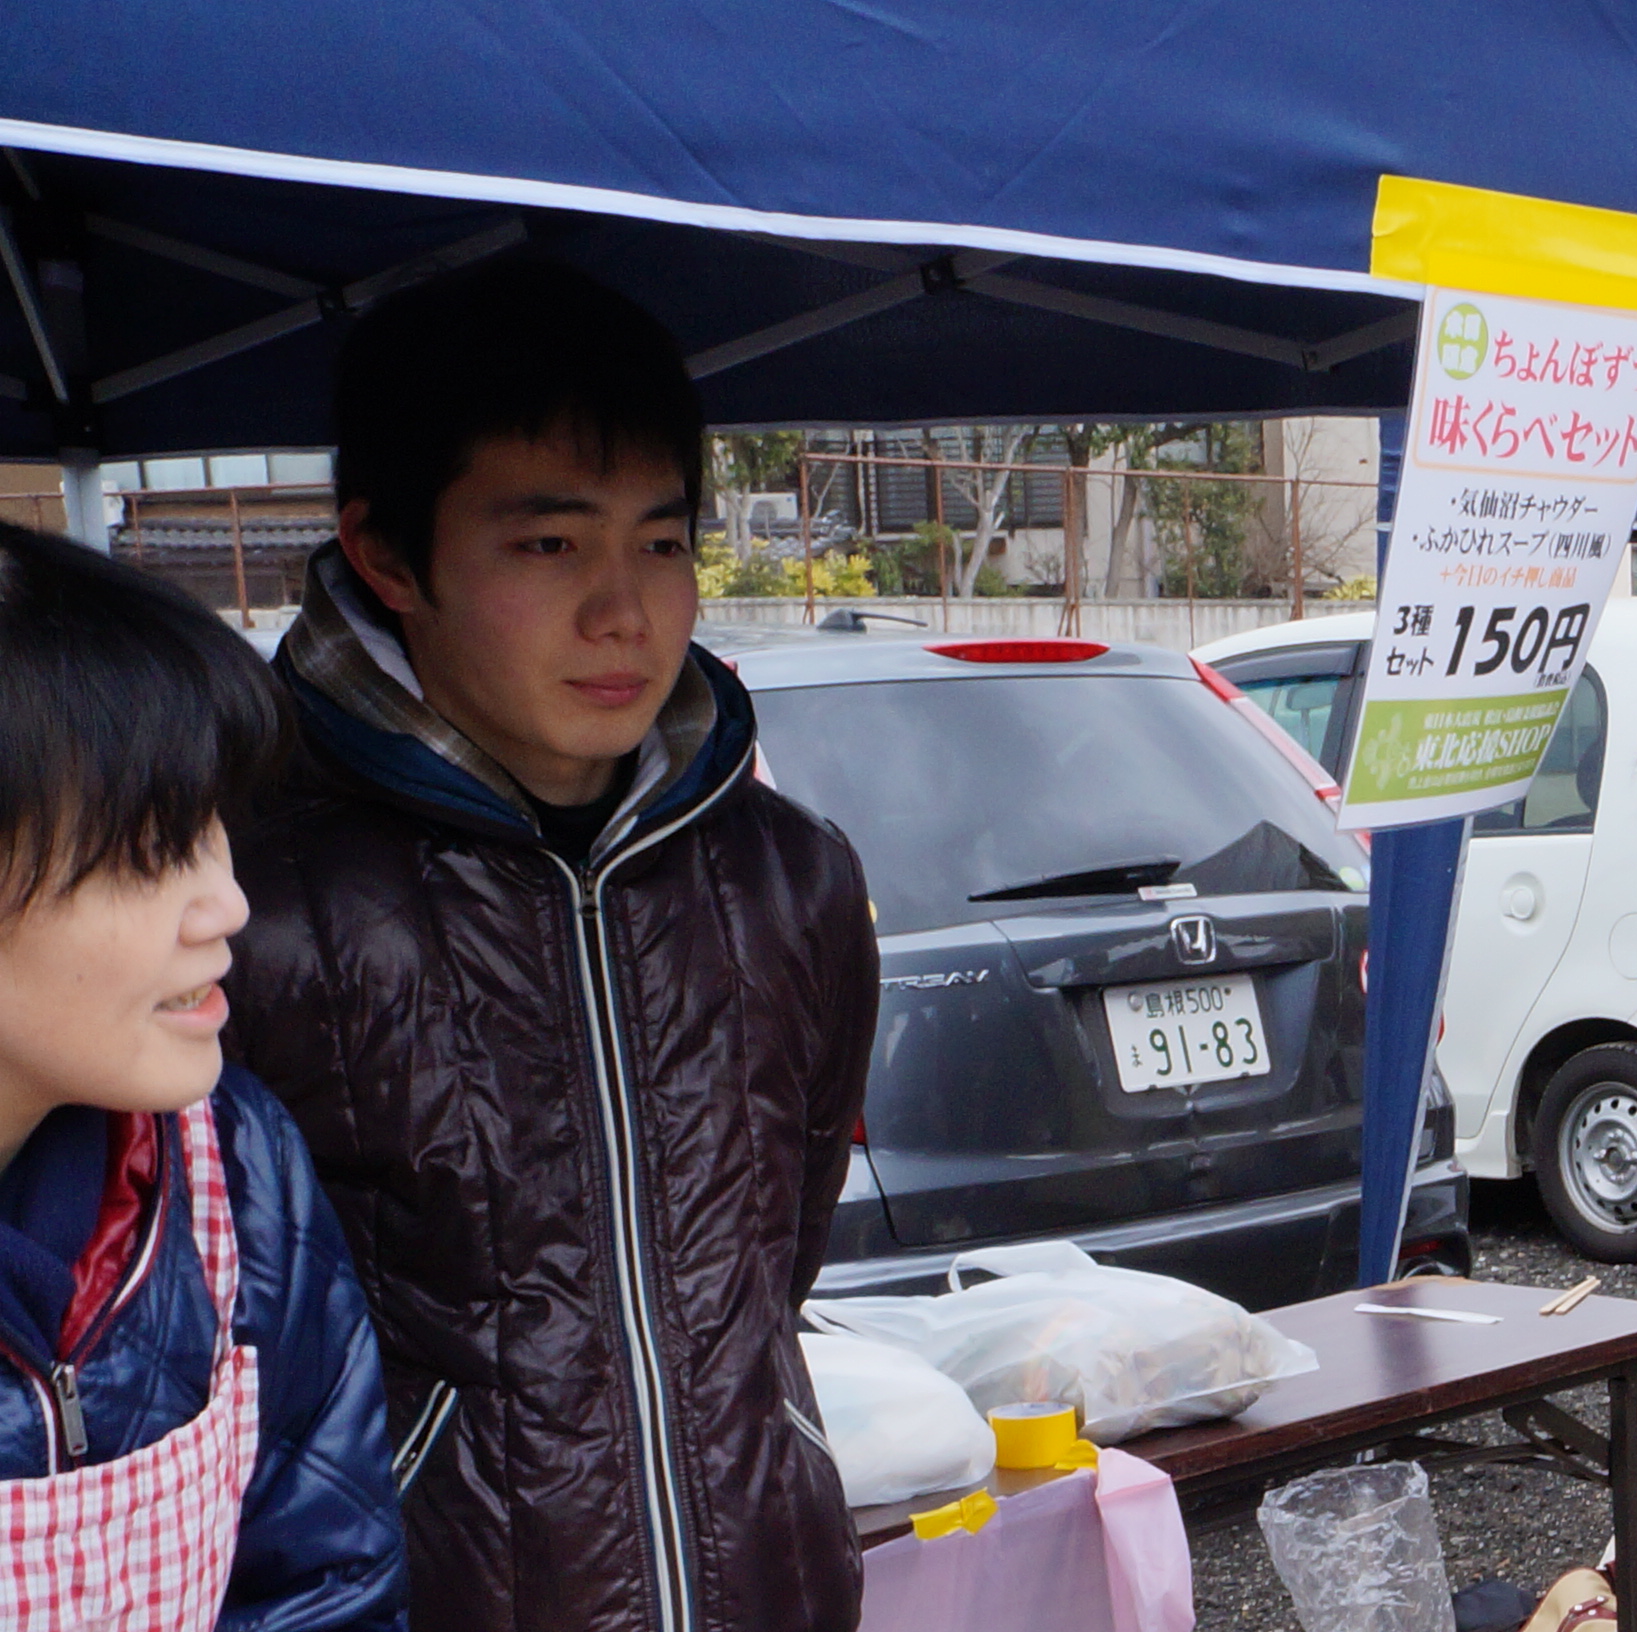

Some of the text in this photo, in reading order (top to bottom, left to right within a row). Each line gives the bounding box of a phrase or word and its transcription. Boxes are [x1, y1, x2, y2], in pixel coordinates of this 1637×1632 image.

[1393, 604, 1434, 637] 3種
[1445, 602, 1591, 677] 150円
[1386, 646, 1434, 677] セット
[1149, 1017, 1258, 1077] 91-83
